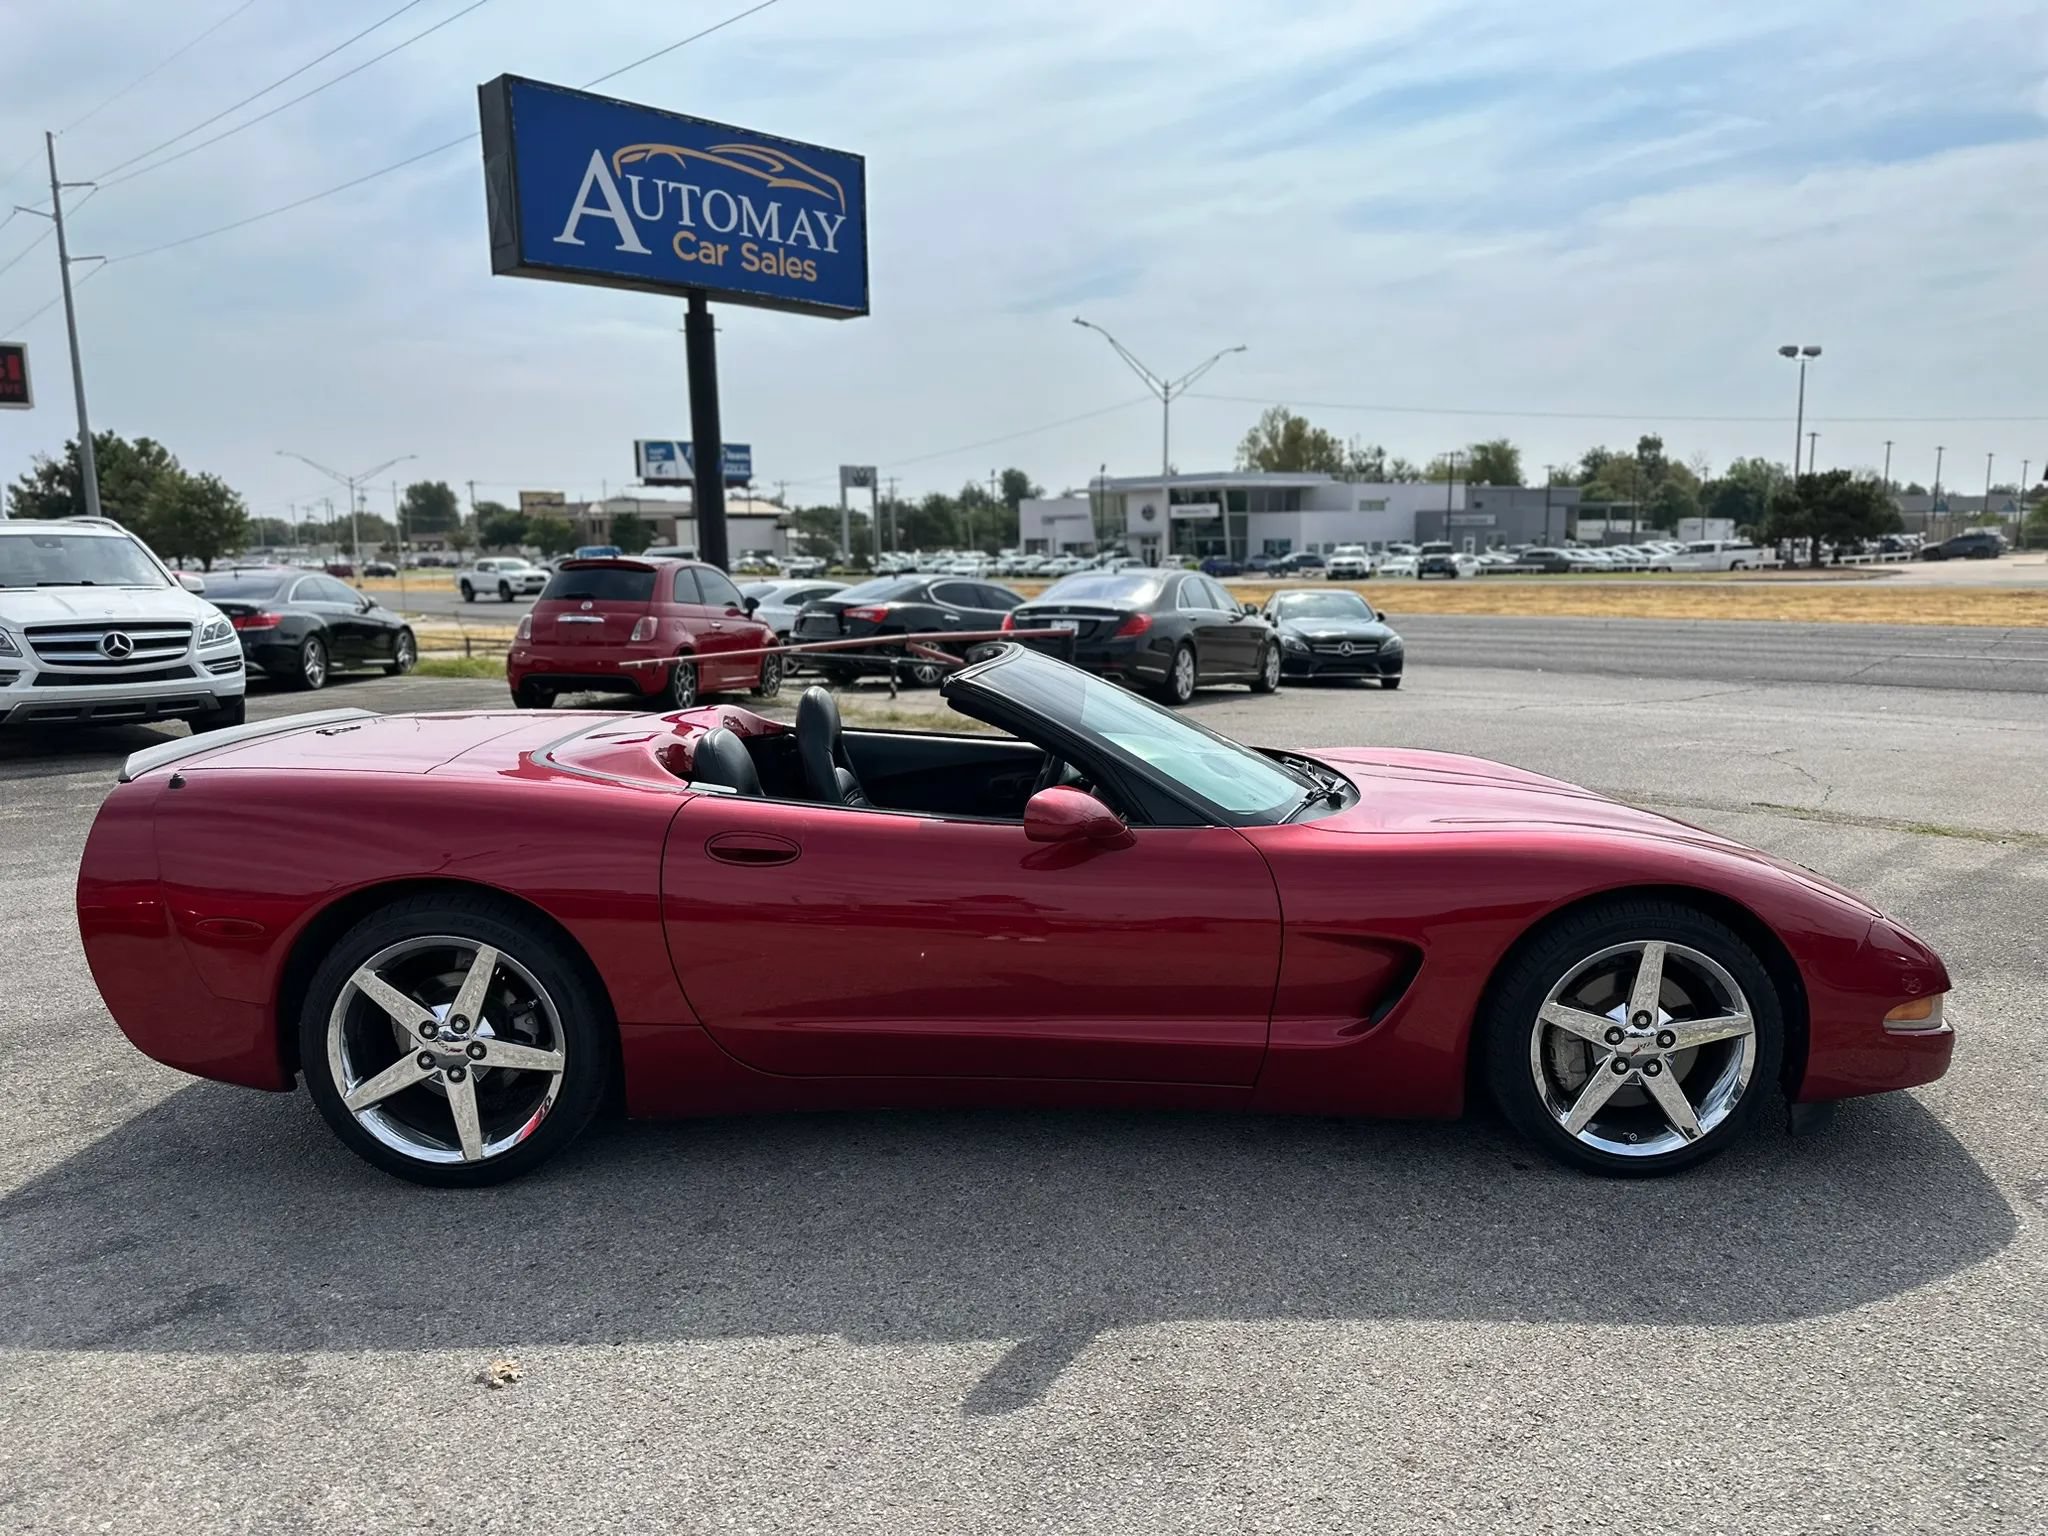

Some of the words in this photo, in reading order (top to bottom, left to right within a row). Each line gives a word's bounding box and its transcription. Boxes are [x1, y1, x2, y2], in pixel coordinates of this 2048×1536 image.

[553, 148, 847, 255] AUTOMAY
[672, 230, 729, 266] Car
[740, 242, 818, 282] Sales
